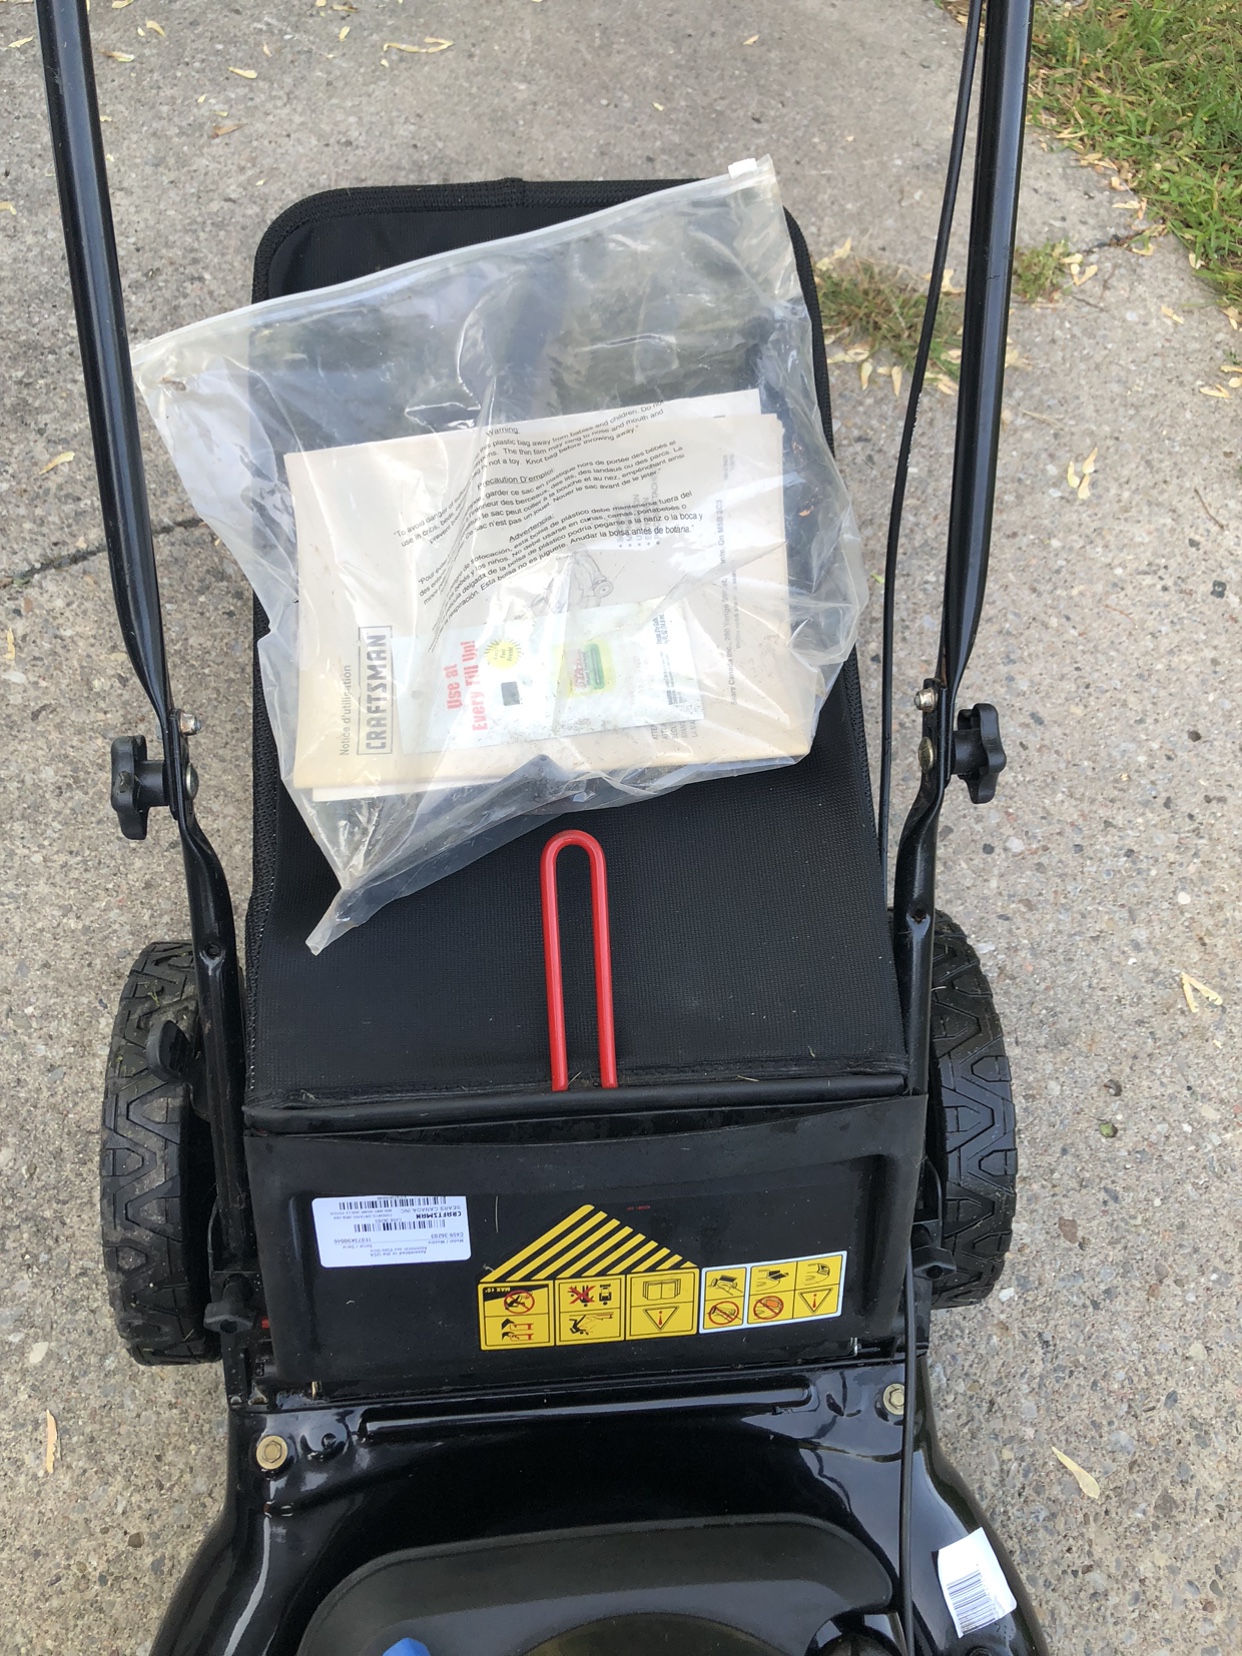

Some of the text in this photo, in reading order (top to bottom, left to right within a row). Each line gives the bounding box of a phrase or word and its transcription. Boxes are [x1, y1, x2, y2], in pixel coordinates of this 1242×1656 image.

[492, 439, 516, 448] plastic
[518, 440, 530, 448] bag
[552, 434, 568, 442] from
[570, 426, 594, 438] babies
[595, 420, 608, 430] and
[544, 452, 558, 462] bag
[559, 442, 582, 453] before
[584, 435, 614, 445] throwing
[548, 442, 562, 452] may
[564, 437, 582, 445] cling
[612, 422, 624, 432] and
[626, 414, 648, 425] mouth
[650, 409, 664, 418] and
[486, 489, 509, 499] garder
[546, 466, 576, 486] plastique
[500, 498, 514, 506] des
[550, 481, 564, 490] des
[578, 468, 592, 476] des
[593, 466, 622, 474] landaus
[635, 458, 648, 466] des
[506, 508, 522, 517] peut
[524, 500, 543, 512] coller
[556, 479, 582, 495] bouche
[668, 453, 685, 462] ainsi
[489, 520, 508, 528] n'est
[552, 490, 574, 502] Nouer
[509, 514, 554, 542] Advertencia:
[514, 538, 529, 549] esta
[530, 526, 549, 540] bolsa
[550, 520, 560, 528] de
[560, 509, 590, 524] plástico
[612, 500, 658, 511] mantenerse
[659, 495, 680, 504] fuera
[680, 490, 693, 500] del
[462, 572, 486, 594] delgada
[488, 568, 498, 576] de
[507, 554, 526, 568] bolsa
[528, 548, 538, 556] de
[538, 534, 566, 552] plástico
[594, 520, 626, 530] pegarse
[644, 514, 661, 523] nariz
[680, 512, 698, 520] boca
[698, 512, 704, 522] y
[480, 578, 496, 592] Esta
[498, 568, 518, 582] bolsa
[518, 562, 528, 570] no
[528, 556, 538, 564] es
[570, 532, 598, 545] Anudar
[600, 529, 608, 538] la
[610, 527, 630, 537] bolsa
[632, 526, 652, 536] antes
[654, 526, 664, 535] de
[512, 549, 522, 557] No
[524, 538, 541, 552] debe
[542, 526, 566, 540] usarse
[460, 640, 478, 662] Up!
[444, 664, 462, 709] Use at
[726, 659, 736, 685] Canada
[366, 634, 388, 750] CRAFTSMAN
[471, 691, 488, 730] Every
[340, 726, 350, 756] Notice
[416, 1211, 462, 1219] CRAFTSMAN
